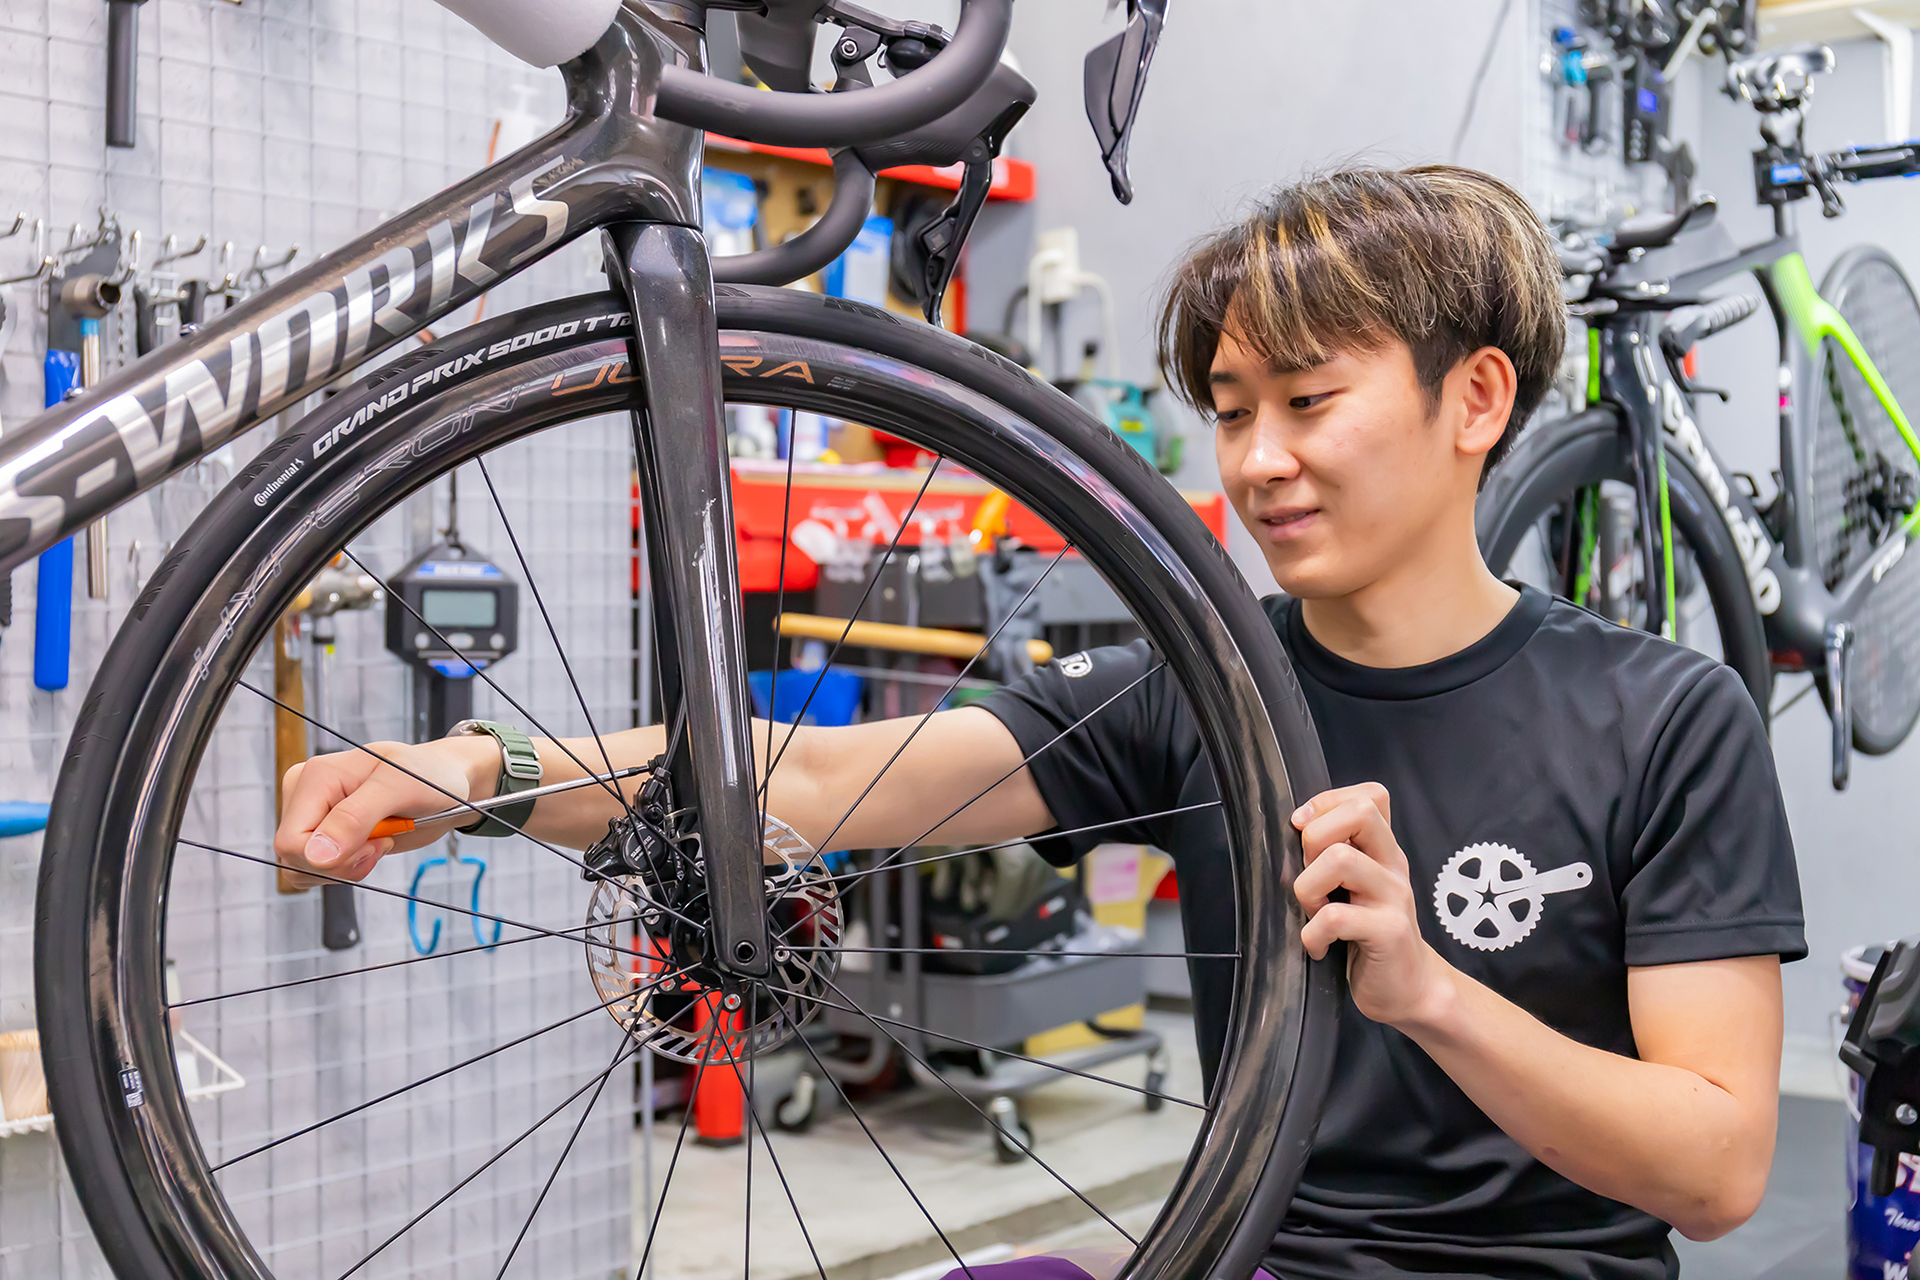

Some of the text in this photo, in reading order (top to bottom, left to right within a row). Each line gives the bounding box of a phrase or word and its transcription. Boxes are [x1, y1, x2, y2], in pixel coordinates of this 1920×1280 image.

[312, 379, 409, 459] GRAND
[412, 347, 486, 396] PRIX
[488, 320, 580, 362] 5000
[551, 354, 815, 396] ULRA
[253, 461, 301, 506] Continental
